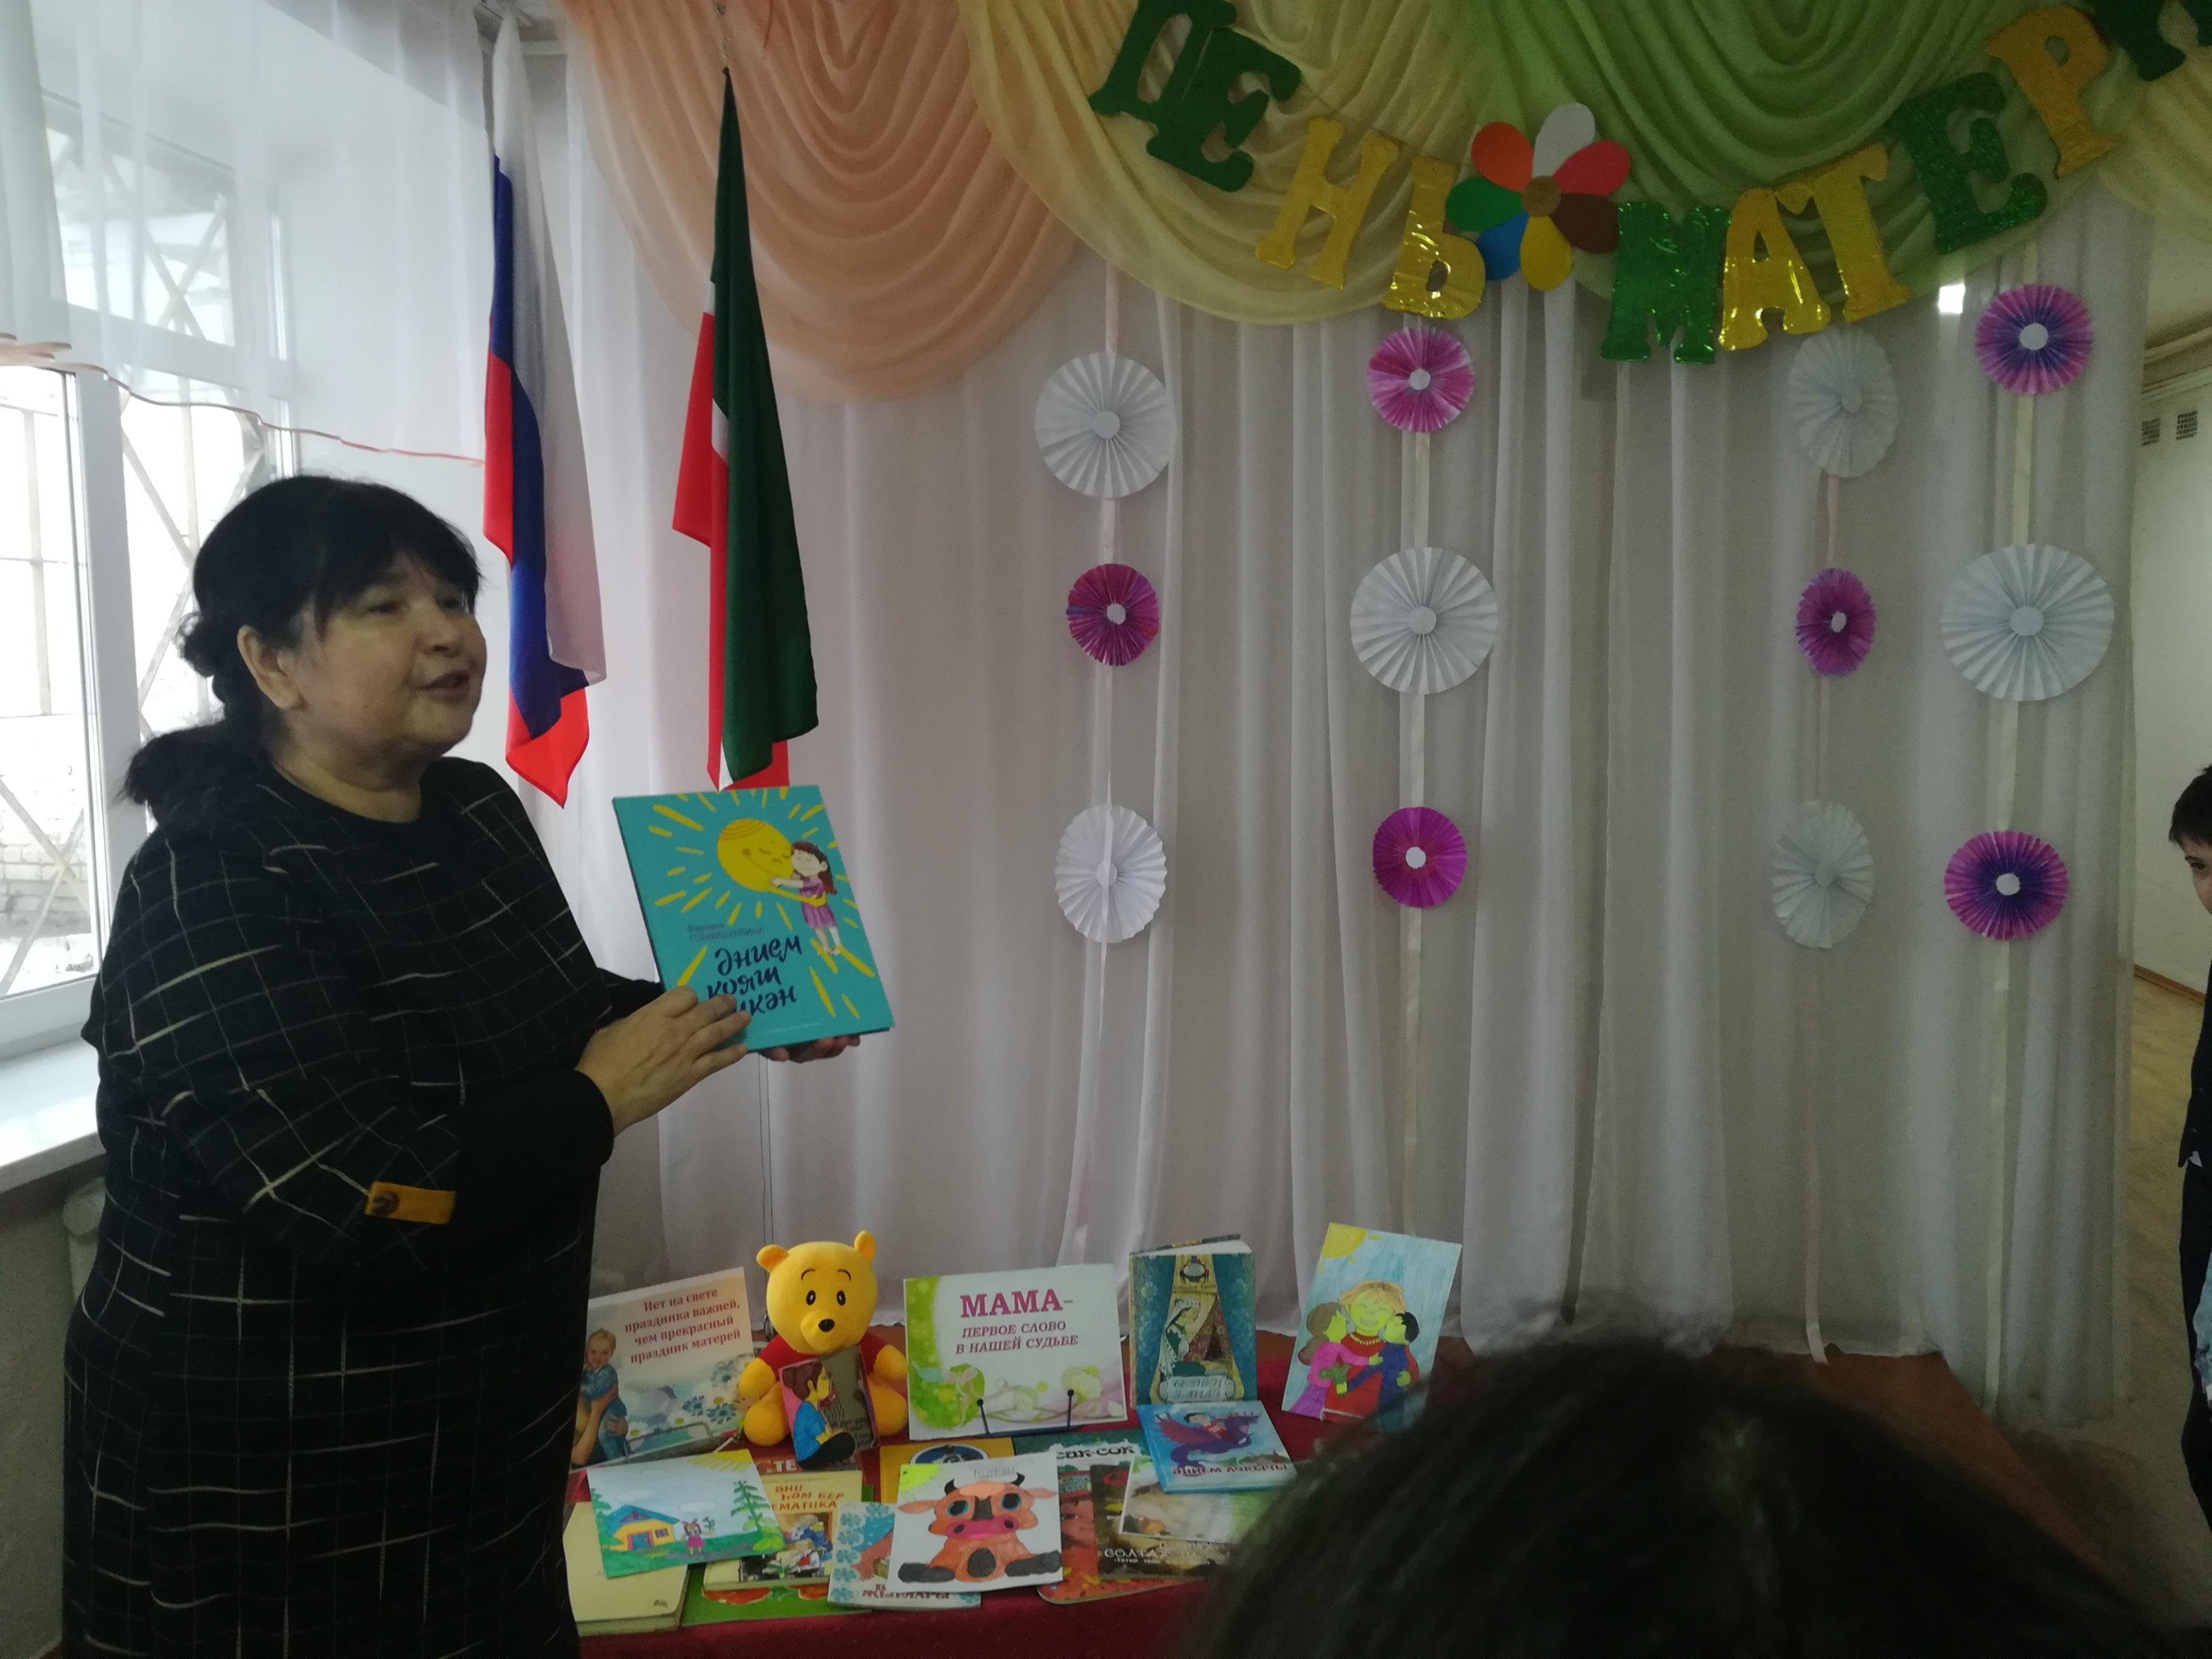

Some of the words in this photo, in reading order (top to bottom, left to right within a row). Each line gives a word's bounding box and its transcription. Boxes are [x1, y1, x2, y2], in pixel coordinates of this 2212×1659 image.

[1088, 0, 1486, 320] ДЕНЬ
[625, 1310, 690, 1333] праздника
[693, 1299, 740, 1317] важней,
[644, 1299, 666, 1312] Нет
[669, 1296, 683, 1307] на
[686, 1289, 718, 1303] свете
[634, 1335, 657, 1346] чем
[661, 1315, 734, 1341] прекрасный
[956, 1343, 965, 1355] В
[969, 1336, 1022, 1353] НАШЕЙ
[1026, 1335, 1079, 1350] СУДЬБЕ
[962, 1324, 1017, 1338] ПЕРВОЕ
[1021, 1321, 1067, 1334] СЛОВО
[631, 1343, 689, 1364] праздник
[692, 1329, 741, 1349] матерей
